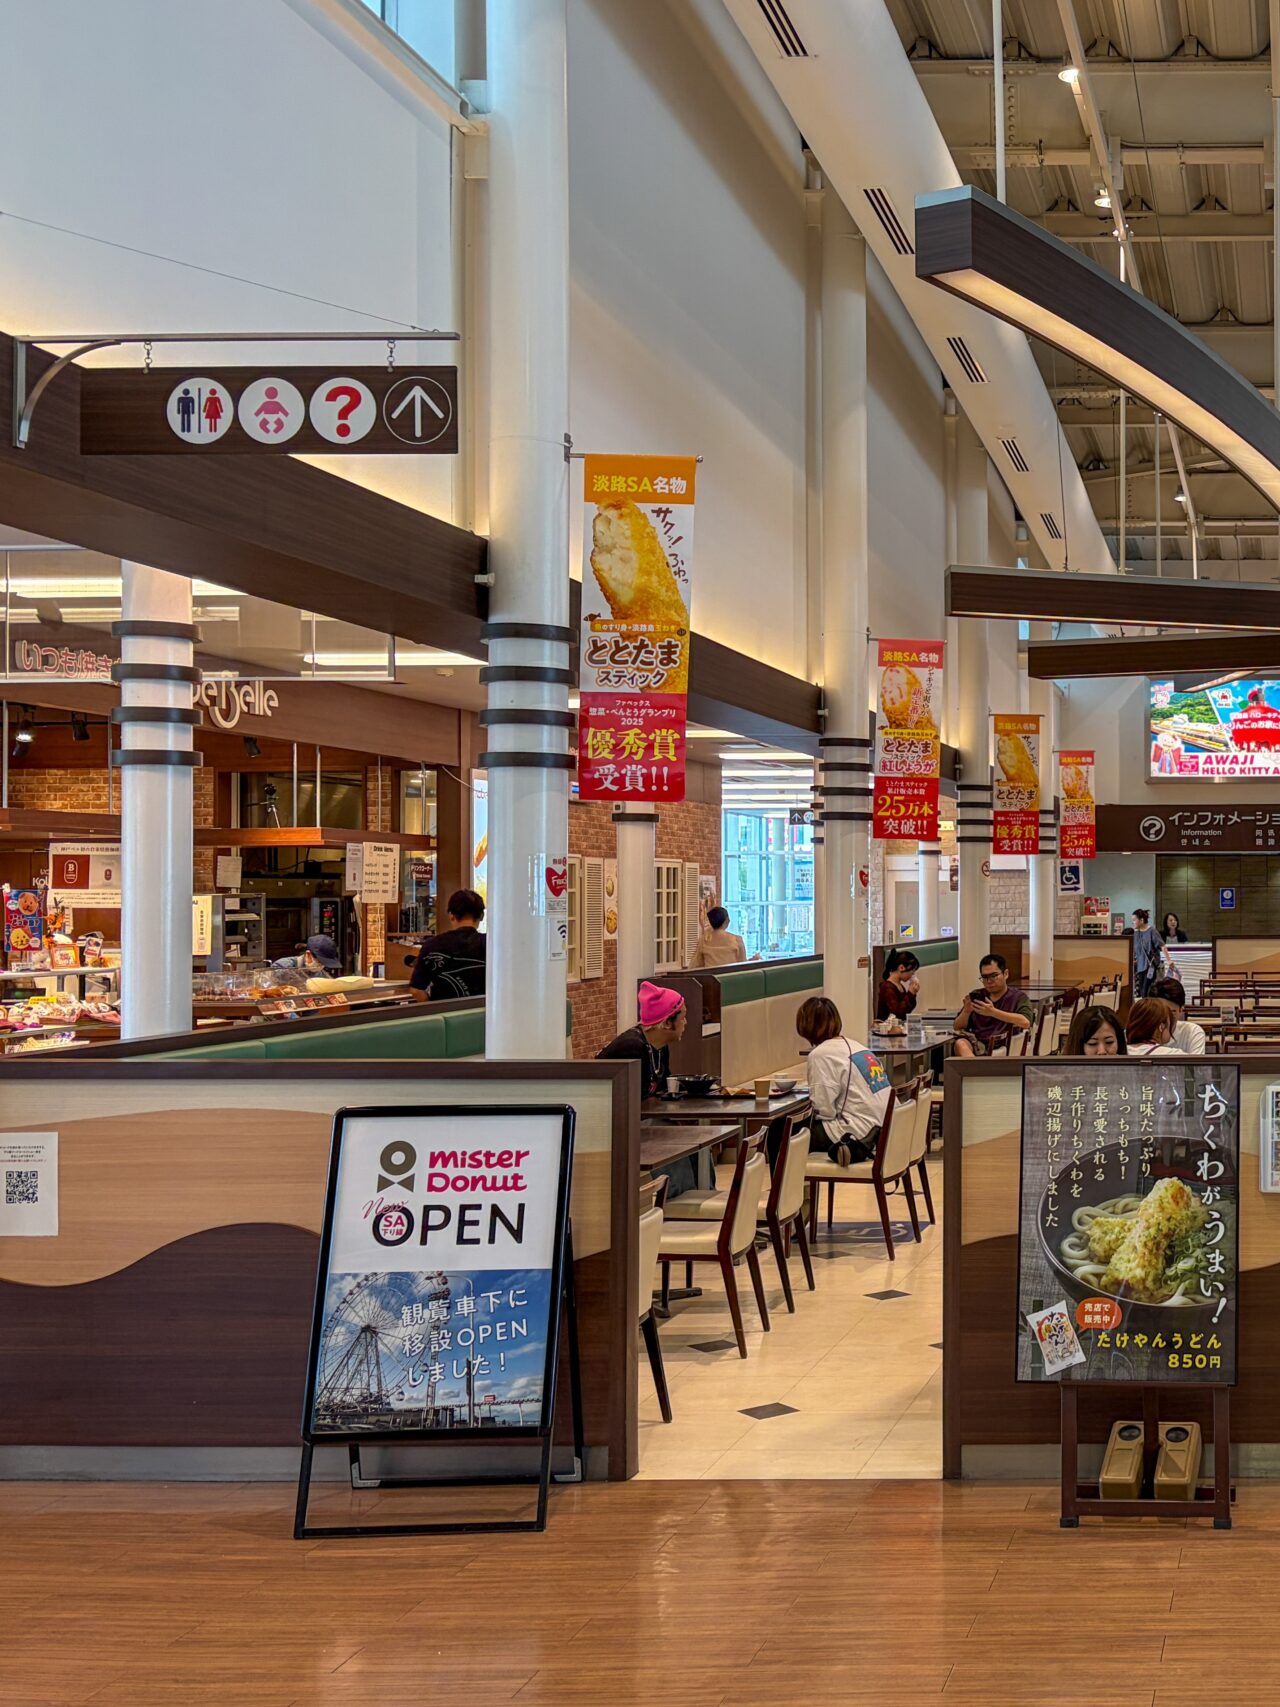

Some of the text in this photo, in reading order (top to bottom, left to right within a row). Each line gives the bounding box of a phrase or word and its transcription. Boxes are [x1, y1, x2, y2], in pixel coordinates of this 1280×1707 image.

[593, 475, 687, 494] 淡路SA名物
[16, 639, 121, 685] いつも焼き
[585, 636, 681, 669] ととたま
[882, 651, 939, 663] 淡路SA名物
[599, 670, 666, 686] スティック
[621, 717, 644, 726] 2025
[585, 728, 680, 761] 優秀賞
[883, 738, 933, 755] ととたま
[880, 759, 936, 774] 紅しょうが
[1202, 754, 1255, 766] AWAJI
[593, 764, 670, 792] 受賞!!
[1202, 767, 1236, 775] HELLO
[1239, 767, 1271, 775] KITTY
[996, 788, 1036, 801] ととたま
[877, 795, 934, 817] 25万本
[1063, 805, 1091, 813] ととたま
[883, 818, 928, 835] 突破!!
[996, 825, 1036, 839] 優秀賞
[1062, 835, 1093, 847] 25万本
[1093, 1086, 1109, 1180] 長年愛される
[1117, 1086, 1130, 1180] もっちもち!
[1139, 1085, 1154, 1177] 旨味たっぷり
[1070, 1085, 1086, 1198] 手作りちくわを
[1045, 1085, 1062, 1228] 磯辺揚げにしました
[427, 1172, 527, 1192] Donut
[362, 1197, 408, 1219] New
[1196, 1084, 1227, 1324] ちくわがうまい!
[372, 1203, 525, 1247] OPEN
[383, 1215, 405, 1228] SA
[401, 1289, 528, 1326] 観覧車下に
[1084, 1303, 1110, 1312] 売店で
[402, 1319, 528, 1357] 移設OPEN
[1097, 1331, 1222, 1349] たけやんうどん
[408, 1352, 506, 1387] しました!
[1168, 1353, 1221, 1369] 850円
